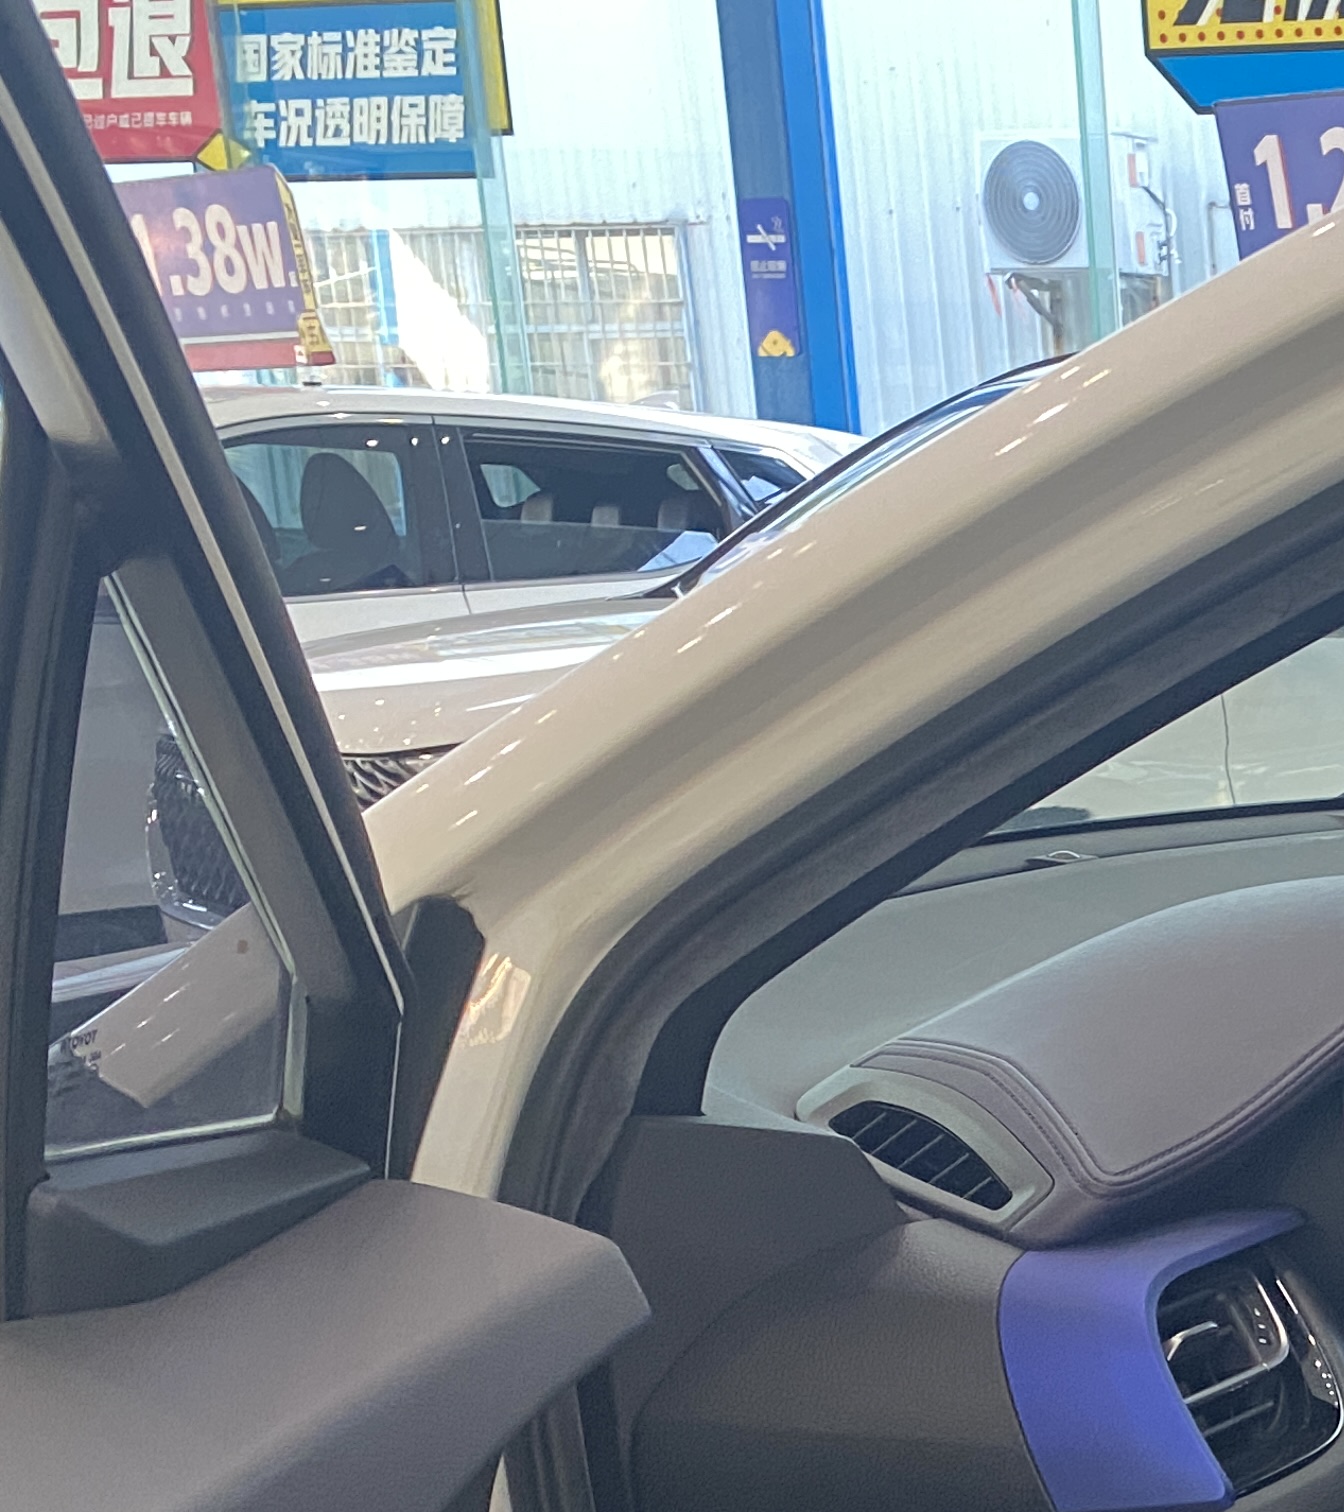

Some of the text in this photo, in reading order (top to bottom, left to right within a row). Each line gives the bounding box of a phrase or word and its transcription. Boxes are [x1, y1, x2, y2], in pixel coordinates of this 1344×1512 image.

[236, 27, 457, 83] 国家标准鉴定
[244, 94, 465, 148] 车况透明保障
